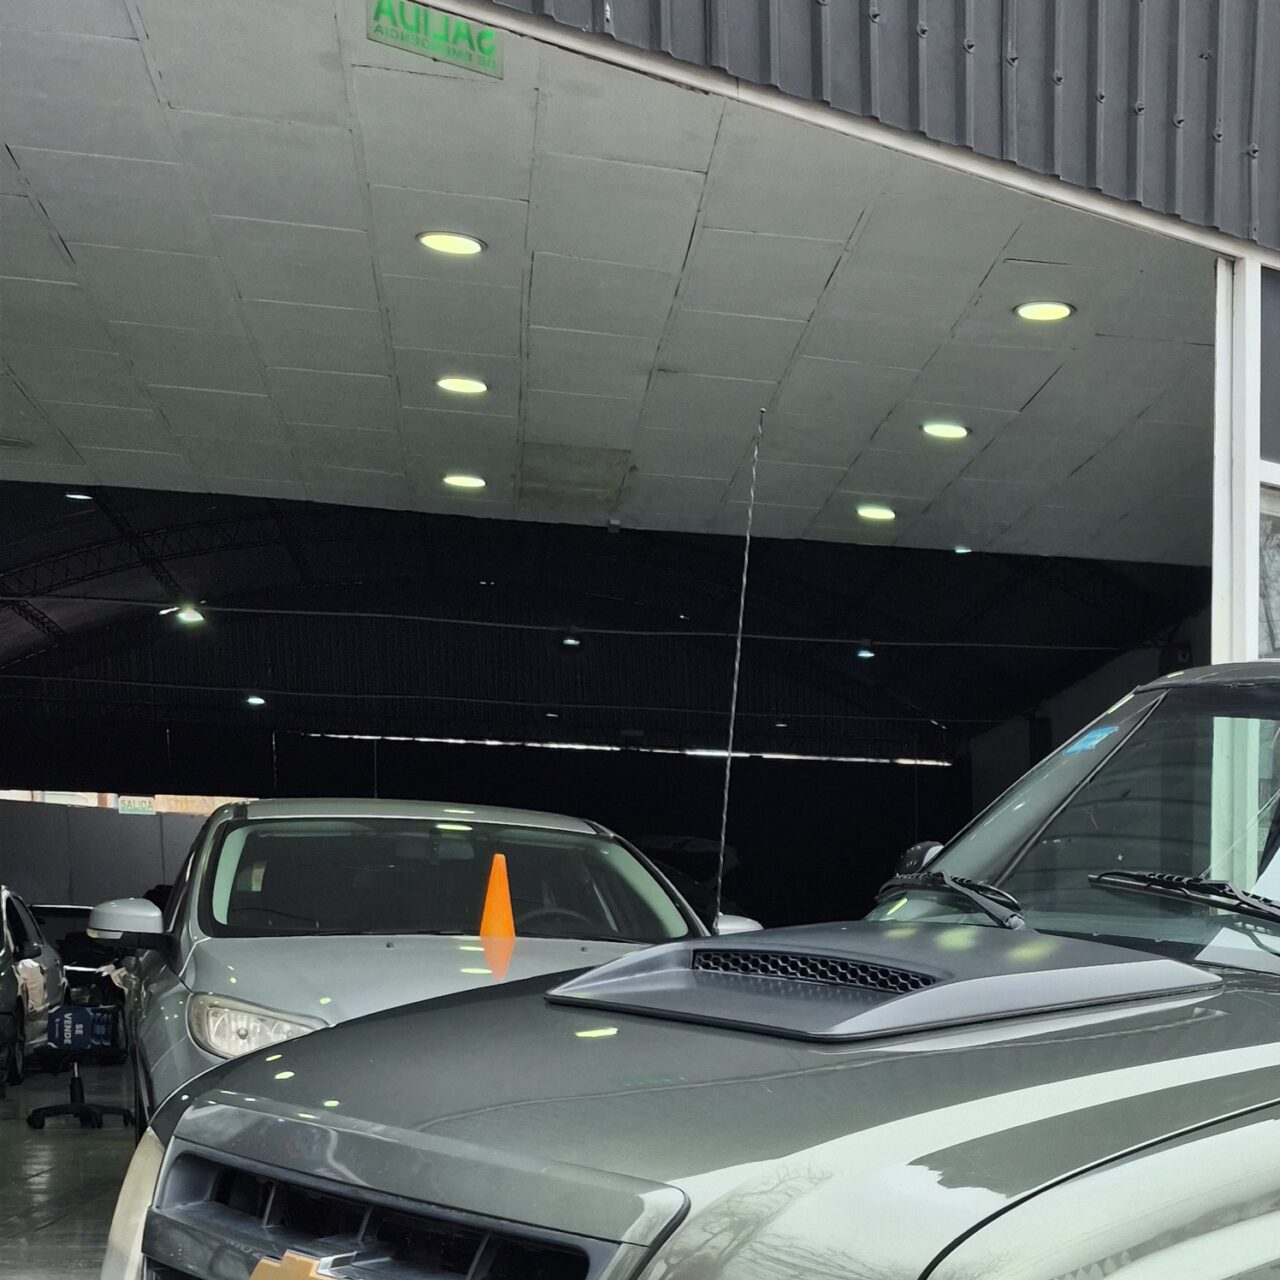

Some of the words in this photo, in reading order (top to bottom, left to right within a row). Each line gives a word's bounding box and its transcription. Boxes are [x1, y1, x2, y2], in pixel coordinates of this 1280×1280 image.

[121, 799, 154, 810] SALIDA
[63, 1012, 73, 1045] VENDE
[75, 1023, 84, 1035] SE
